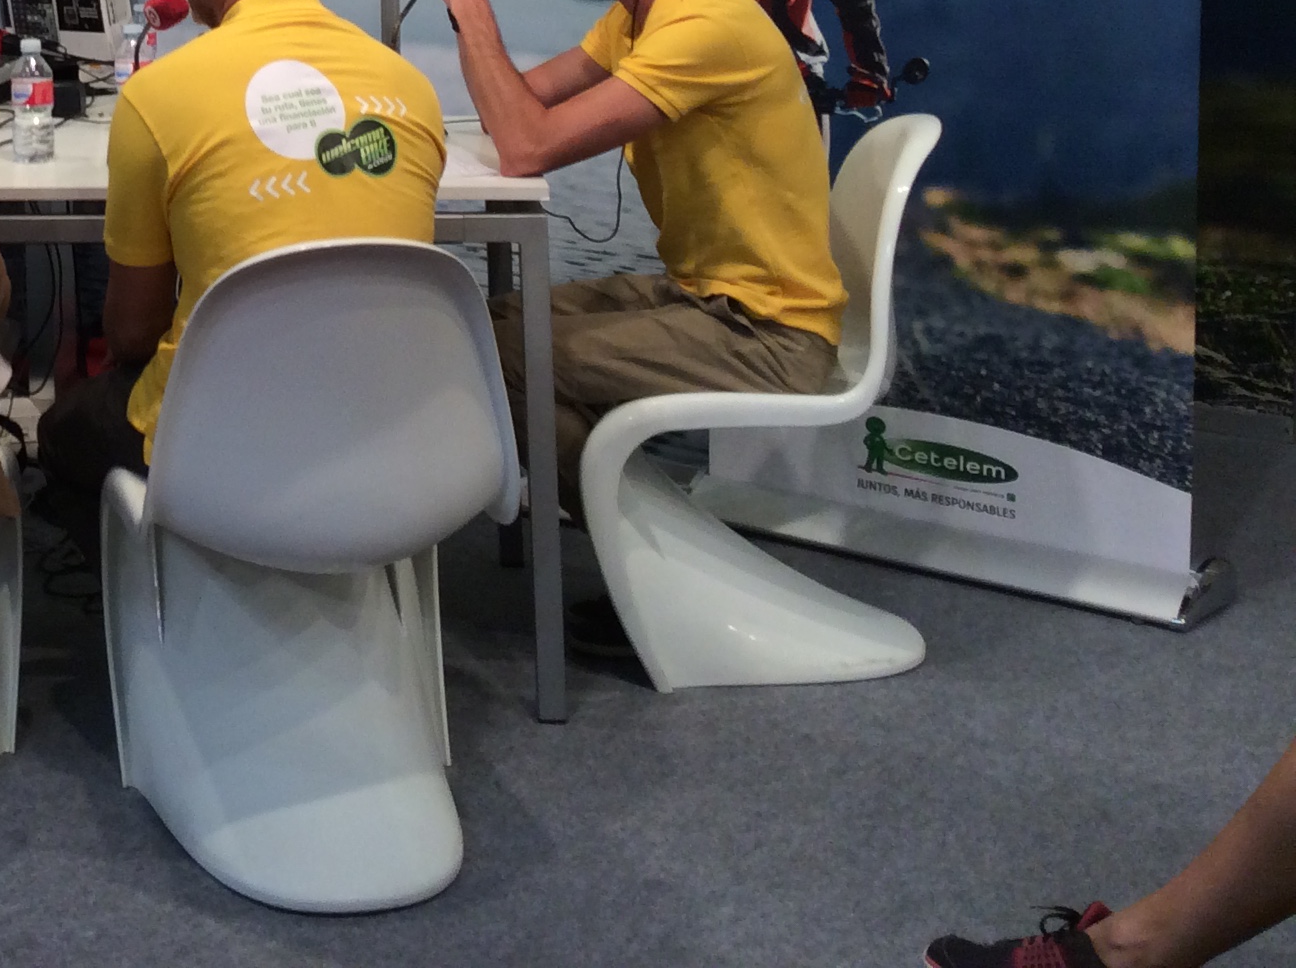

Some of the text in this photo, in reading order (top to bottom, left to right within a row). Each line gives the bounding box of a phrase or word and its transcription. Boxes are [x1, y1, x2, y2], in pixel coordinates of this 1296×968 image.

[894, 444, 1006, 481] Cetelem
[856, 478, 1017, 520] JUNTOS, MÁS RESPONSABLES
